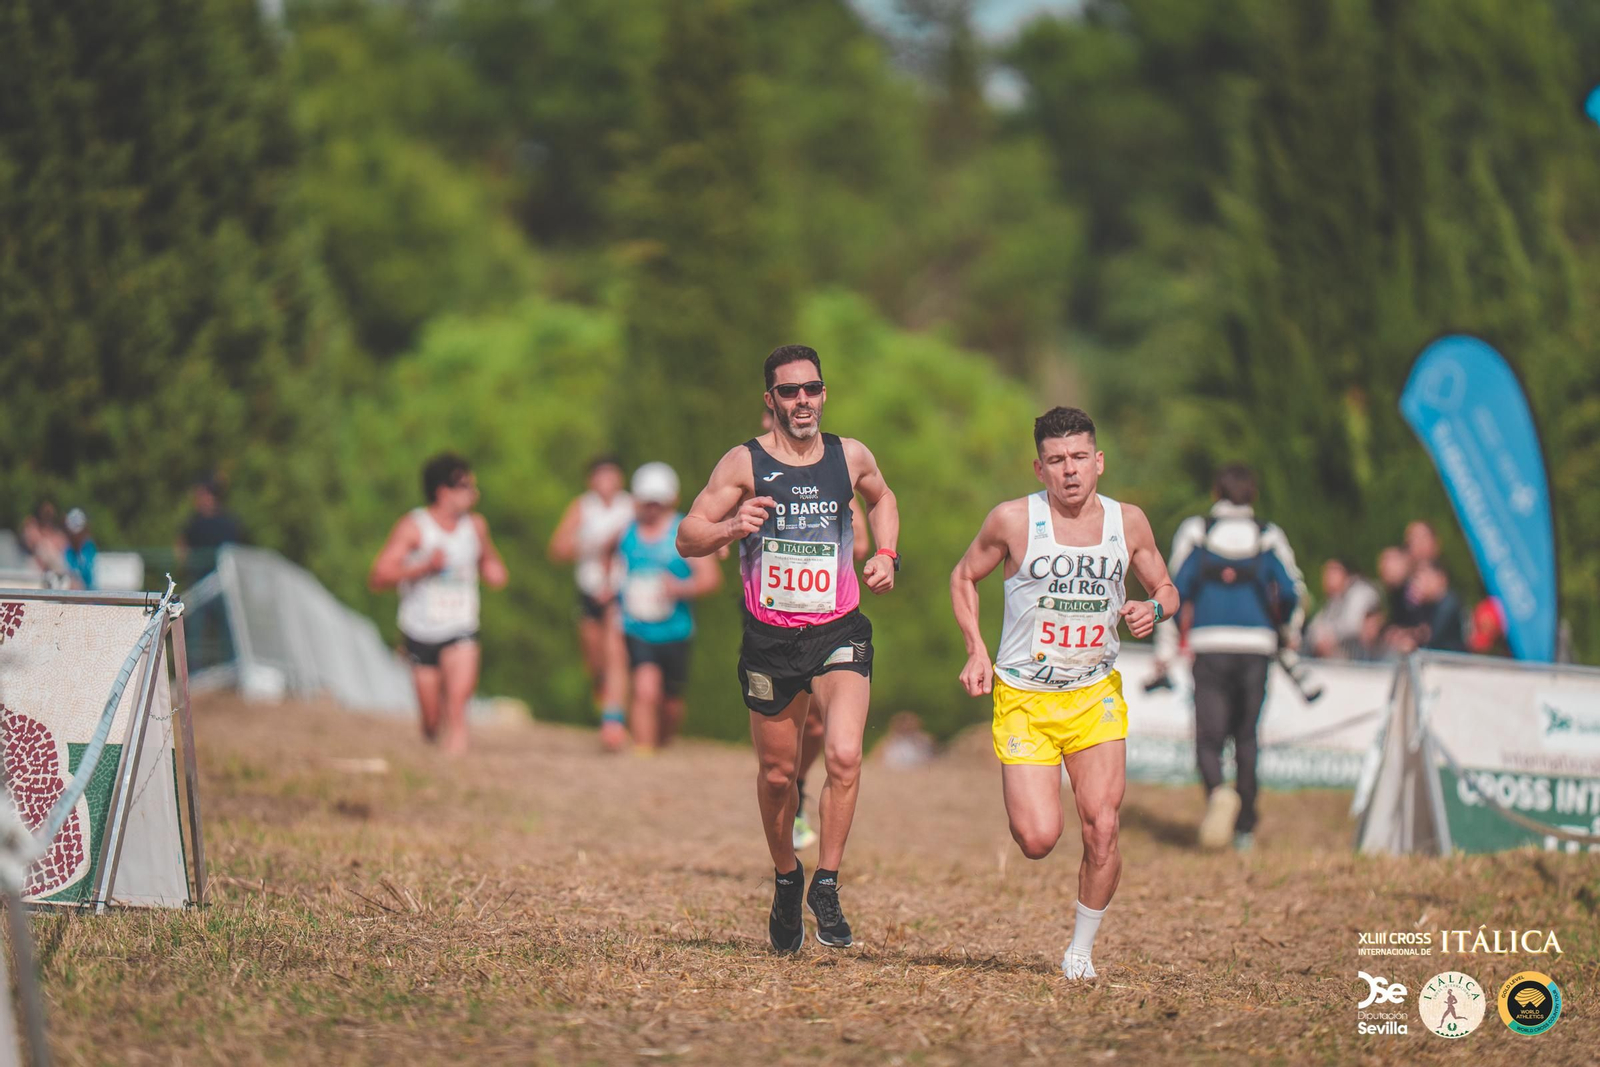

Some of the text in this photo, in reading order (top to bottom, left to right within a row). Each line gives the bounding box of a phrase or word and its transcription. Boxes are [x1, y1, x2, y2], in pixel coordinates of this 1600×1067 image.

[791, 485, 819, 495] CUPA
[775, 501, 838, 516] O BARCO
[782, 543, 817, 554] ITÁLICA
[767, 565, 831, 593] 5100
[1029, 553, 1123, 583] CORIA
[1048, 578, 1106, 596] del Río
[1040, 620, 1105, 649] 5112
[1457, 771, 1553, 812] CROSS
